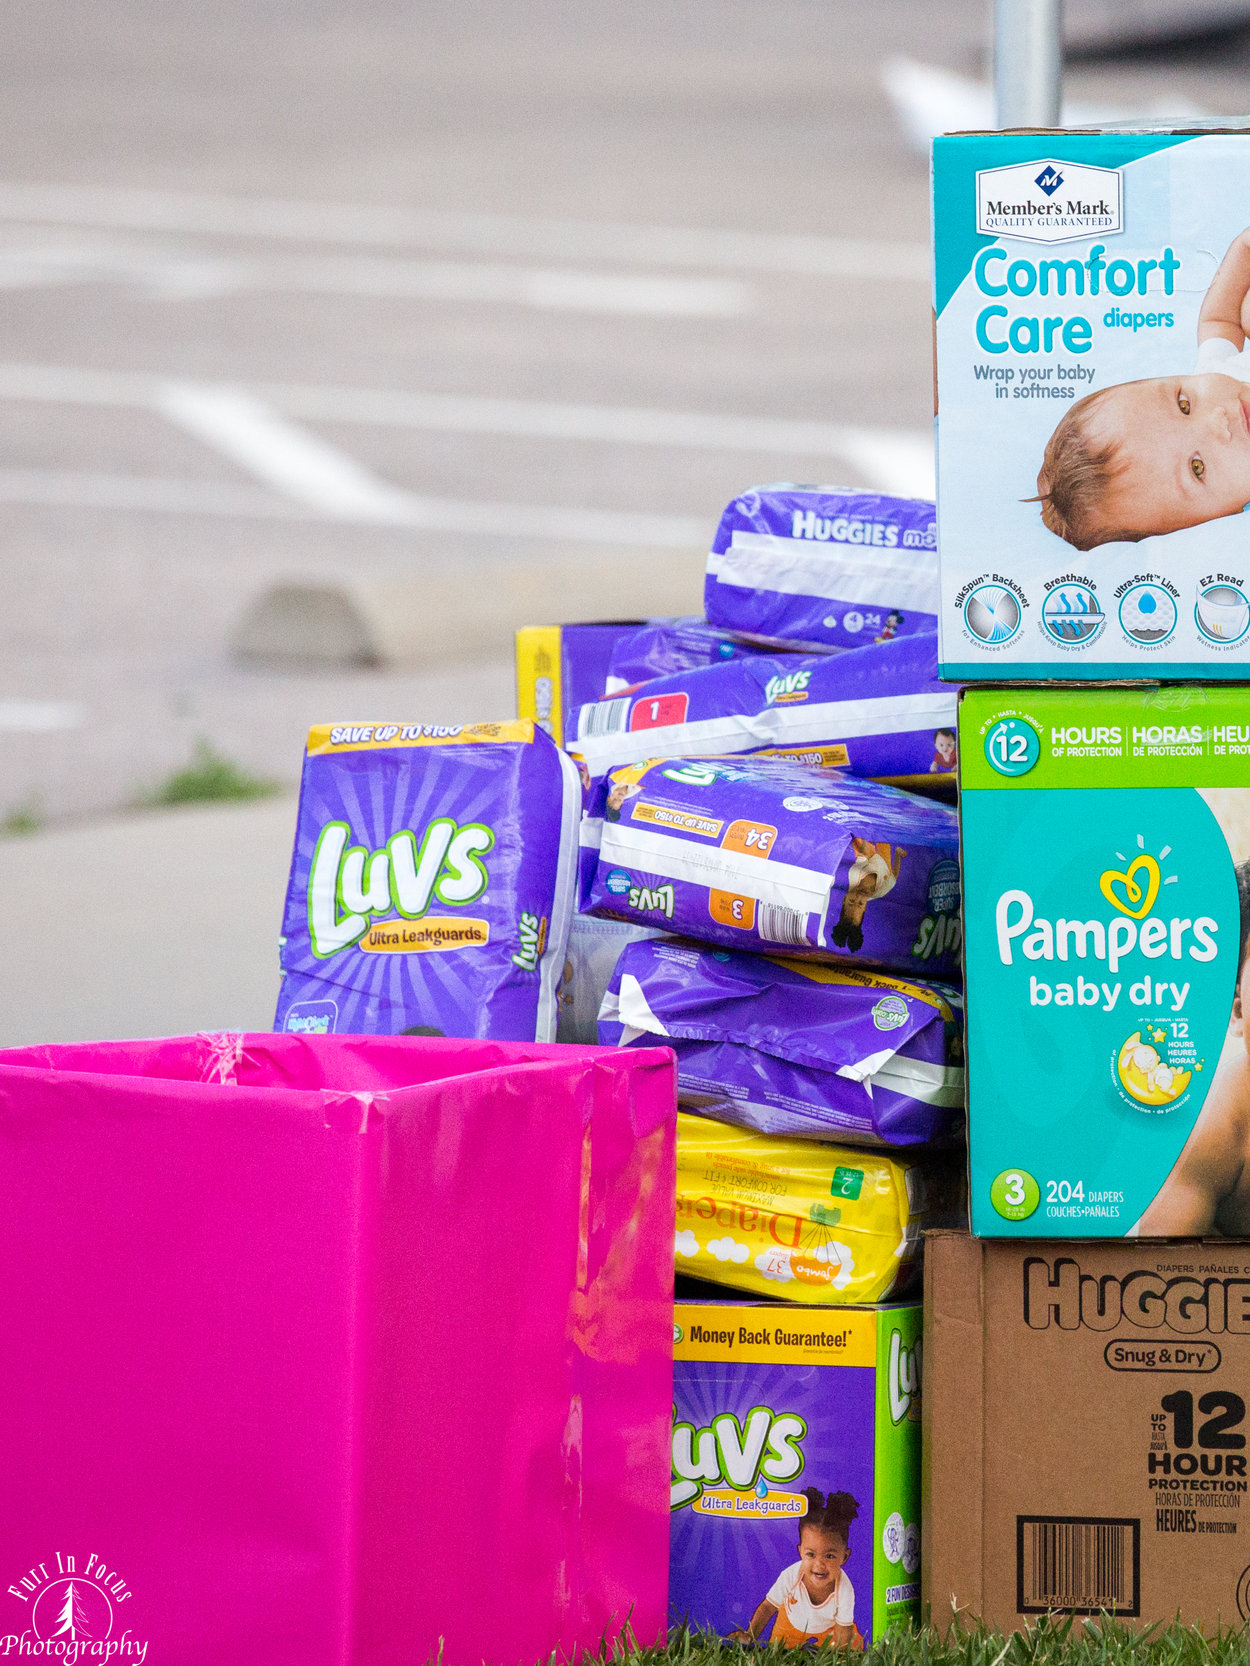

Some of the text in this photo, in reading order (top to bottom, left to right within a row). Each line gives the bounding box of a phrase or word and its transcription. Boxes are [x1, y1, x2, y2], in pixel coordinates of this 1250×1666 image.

[986, 201, 1111, 216] Member's Mark
[986, 217, 1112, 228] QUALITY GUARANTEED
[974, 245, 1180, 296] Comfort
[976, 305, 1174, 354] Care diapers
[974, 364, 1095, 384] Wrap your baby
[995, 383, 1075, 399] in softness
[792, 510, 898, 547] HUGGIES
[1044, 573, 1097, 592] Breathable
[1217, 573, 1244, 587] Read
[992, 574, 1030, 608] Backsheet
[765, 671, 812, 707] Luvs
[330, 725, 421, 744] SAVE UP TO
[1051, 727, 1122, 744] HOURS
[1132, 726, 1202, 743] HORAS
[996, 735, 1028, 762] 12
[1052, 748, 1065, 756] OF
[1066, 747, 1122, 757] PROTECTION
[1132, 746, 1145, 756] DE
[1147, 743, 1203, 756] PROTECCIÓN
[1214, 746, 1226, 755] DE
[309, 817, 495, 959] Luvs
[628, 883, 675, 918] Luvs
[369, 927, 481, 946] Ultra Leakguards
[996, 890, 1219, 973] Pampers
[512, 911, 539, 972] Luvs
[1030, 975, 1190, 1012] baby dry
[1170, 1022, 1189, 1038] 12
[729, 1175, 768, 1194] COMFORT
[840, 1176, 853, 1195] 2
[1005, 1173, 1026, 1206] 3
[1046, 1180, 1124, 1203] 204 DIAPERS
[767, 1258, 786, 1274] 37
[1156, 1264, 1194, 1273] DIAPERS
[1199, 1263, 1239, 1274] PAÑALES
[690, 1325, 771, 1348] Money Back
[1114, 1348, 1156, 1367] Snug
[1159, 1349, 1171, 1363] &
[1151, 1414, 1167, 1422] UP
[1152, 1423, 1166, 1431] TO
[1161, 1390, 1246, 1450] 12
[1148, 1452, 1247, 1476] HOUR
[1149, 1479, 1247, 1491] PROTECTION
[701, 1496, 801, 1513] Ultra Leakguards
[1195, 1492, 1240, 1508] PROTECCIÓN
[1156, 1509, 1196, 1533] HEURES
